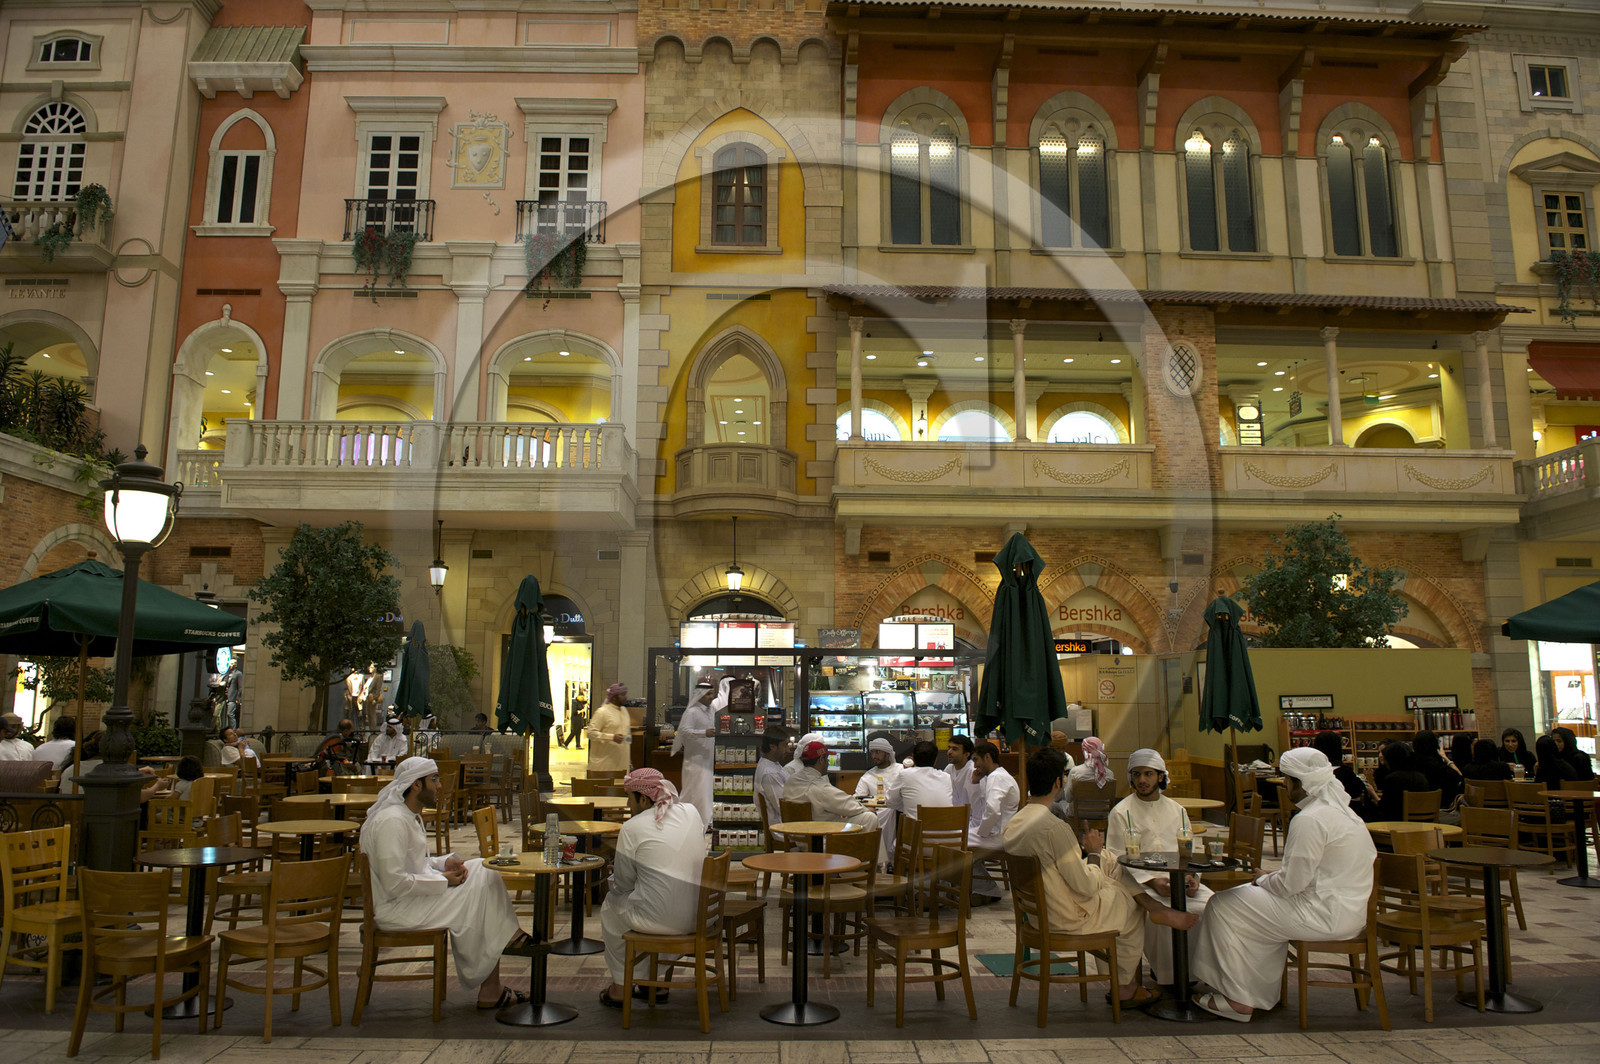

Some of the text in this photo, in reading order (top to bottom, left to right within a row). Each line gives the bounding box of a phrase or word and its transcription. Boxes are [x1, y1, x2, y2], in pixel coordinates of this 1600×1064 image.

[8, 288, 67, 299] LEVANTE
[1059, 604, 1122, 621] Bershka
[183, 628, 217, 637] STARBUCKS
[1054, 642, 1087, 652] ershka
